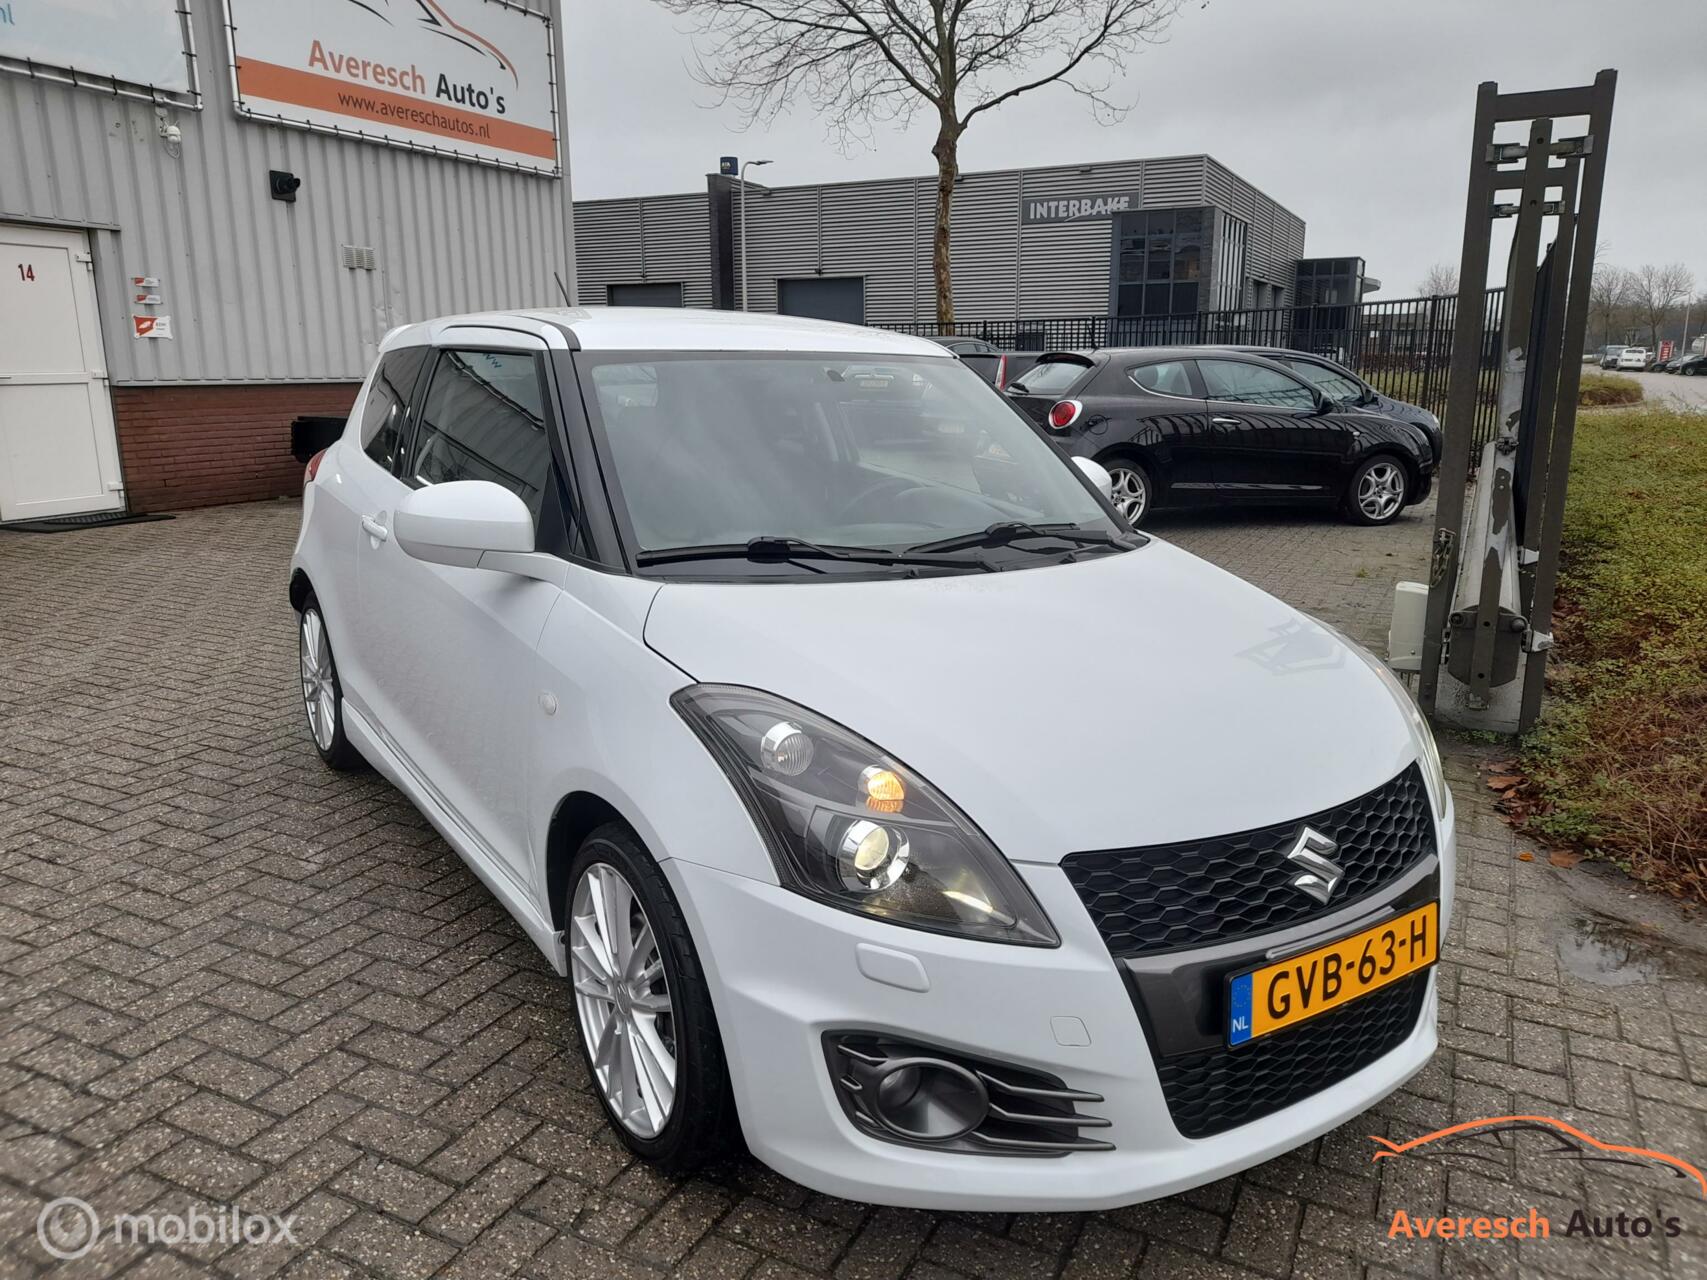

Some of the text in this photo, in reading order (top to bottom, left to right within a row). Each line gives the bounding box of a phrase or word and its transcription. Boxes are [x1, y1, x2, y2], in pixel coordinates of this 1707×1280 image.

[308, 39, 506, 115] Averesch Auto's
[337, 91, 491, 140] www.avereschautos.nl
[1030, 196, 1129, 221] INTERBAKE
[18, 264, 35, 281] 14
[1266, 914, 1428, 1019] GVB-63-H
[1232, 1015, 1249, 1034] NL
